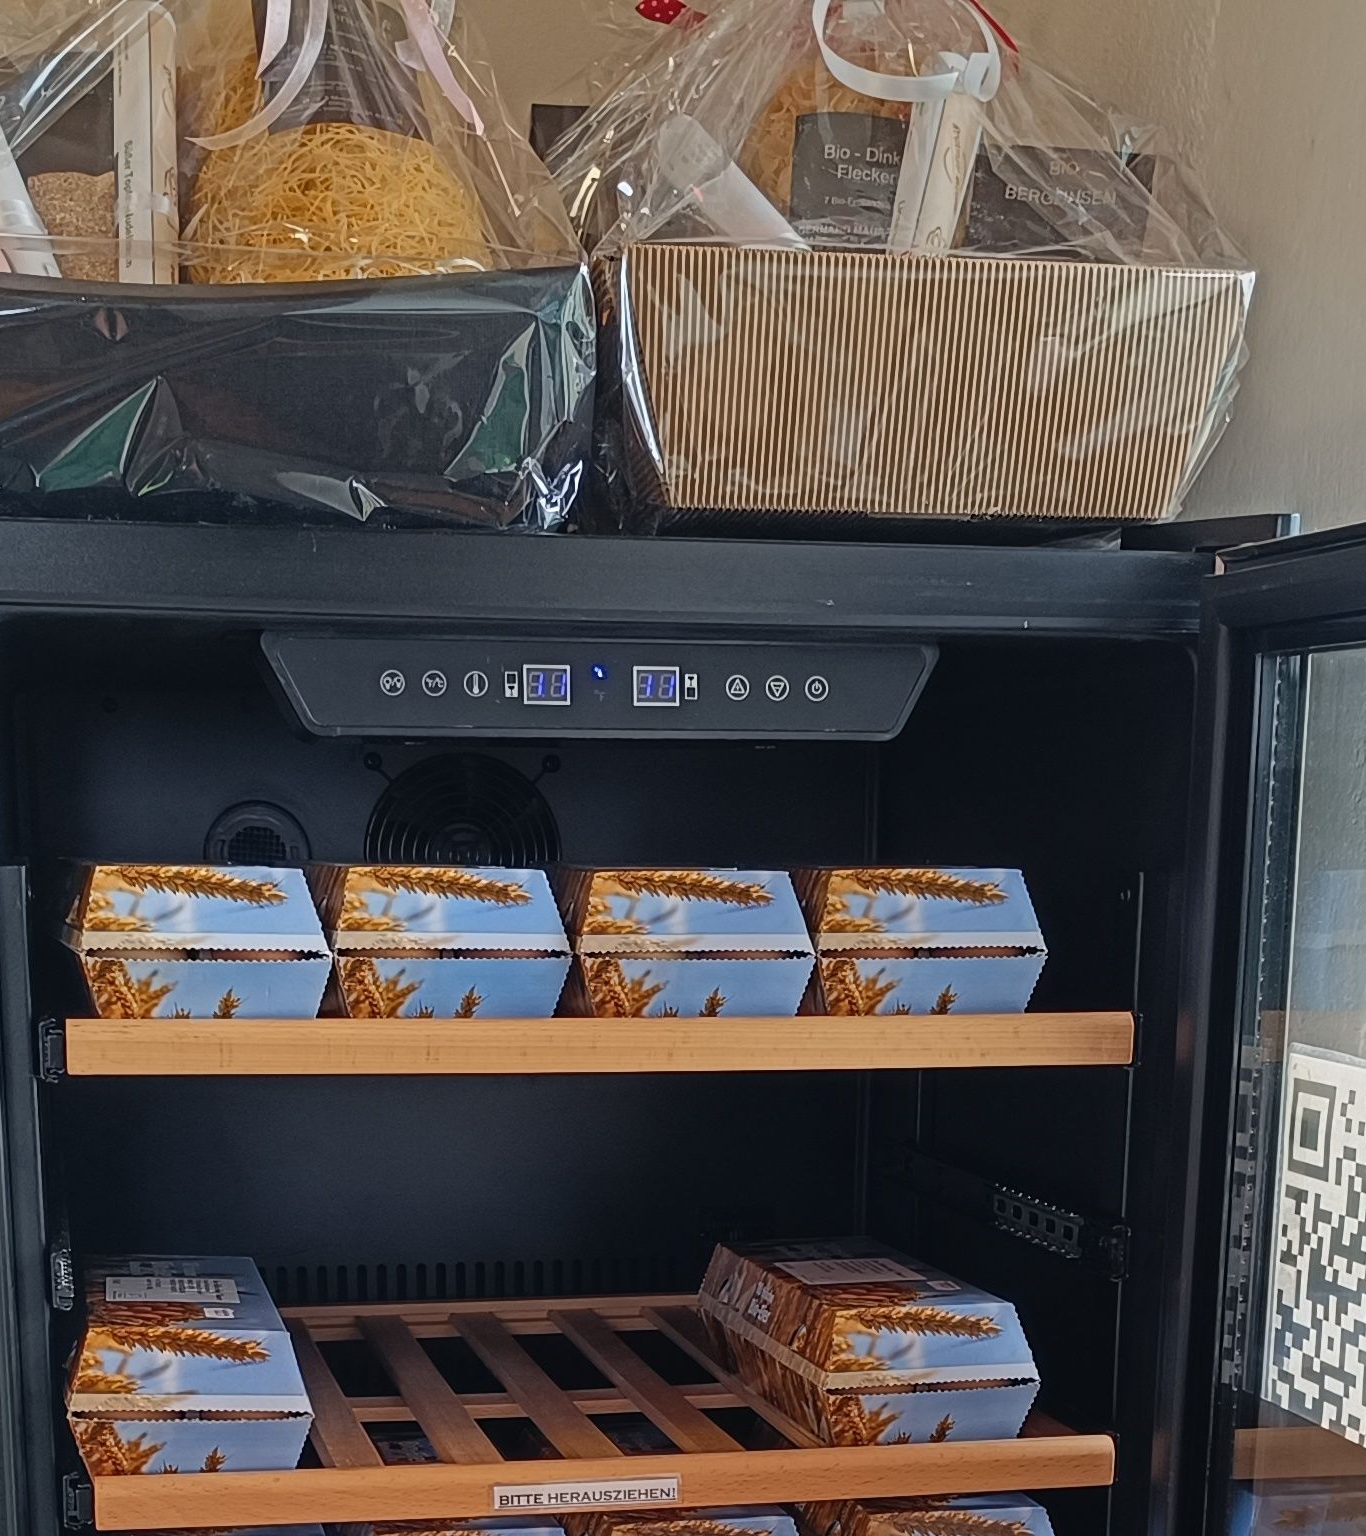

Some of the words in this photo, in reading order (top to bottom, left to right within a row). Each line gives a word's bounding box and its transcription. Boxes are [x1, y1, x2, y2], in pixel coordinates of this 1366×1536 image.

[824, 144, 851, 160] Bio
[866, 146, 901, 166] Dink
[837, 164, 898, 184] Flecker
[1004, 184, 1117, 207] BERGINSEN
[499, 1493, 544, 1507] BITTE
[547, 1487, 677, 1504] HERAUSZIEHEN!
